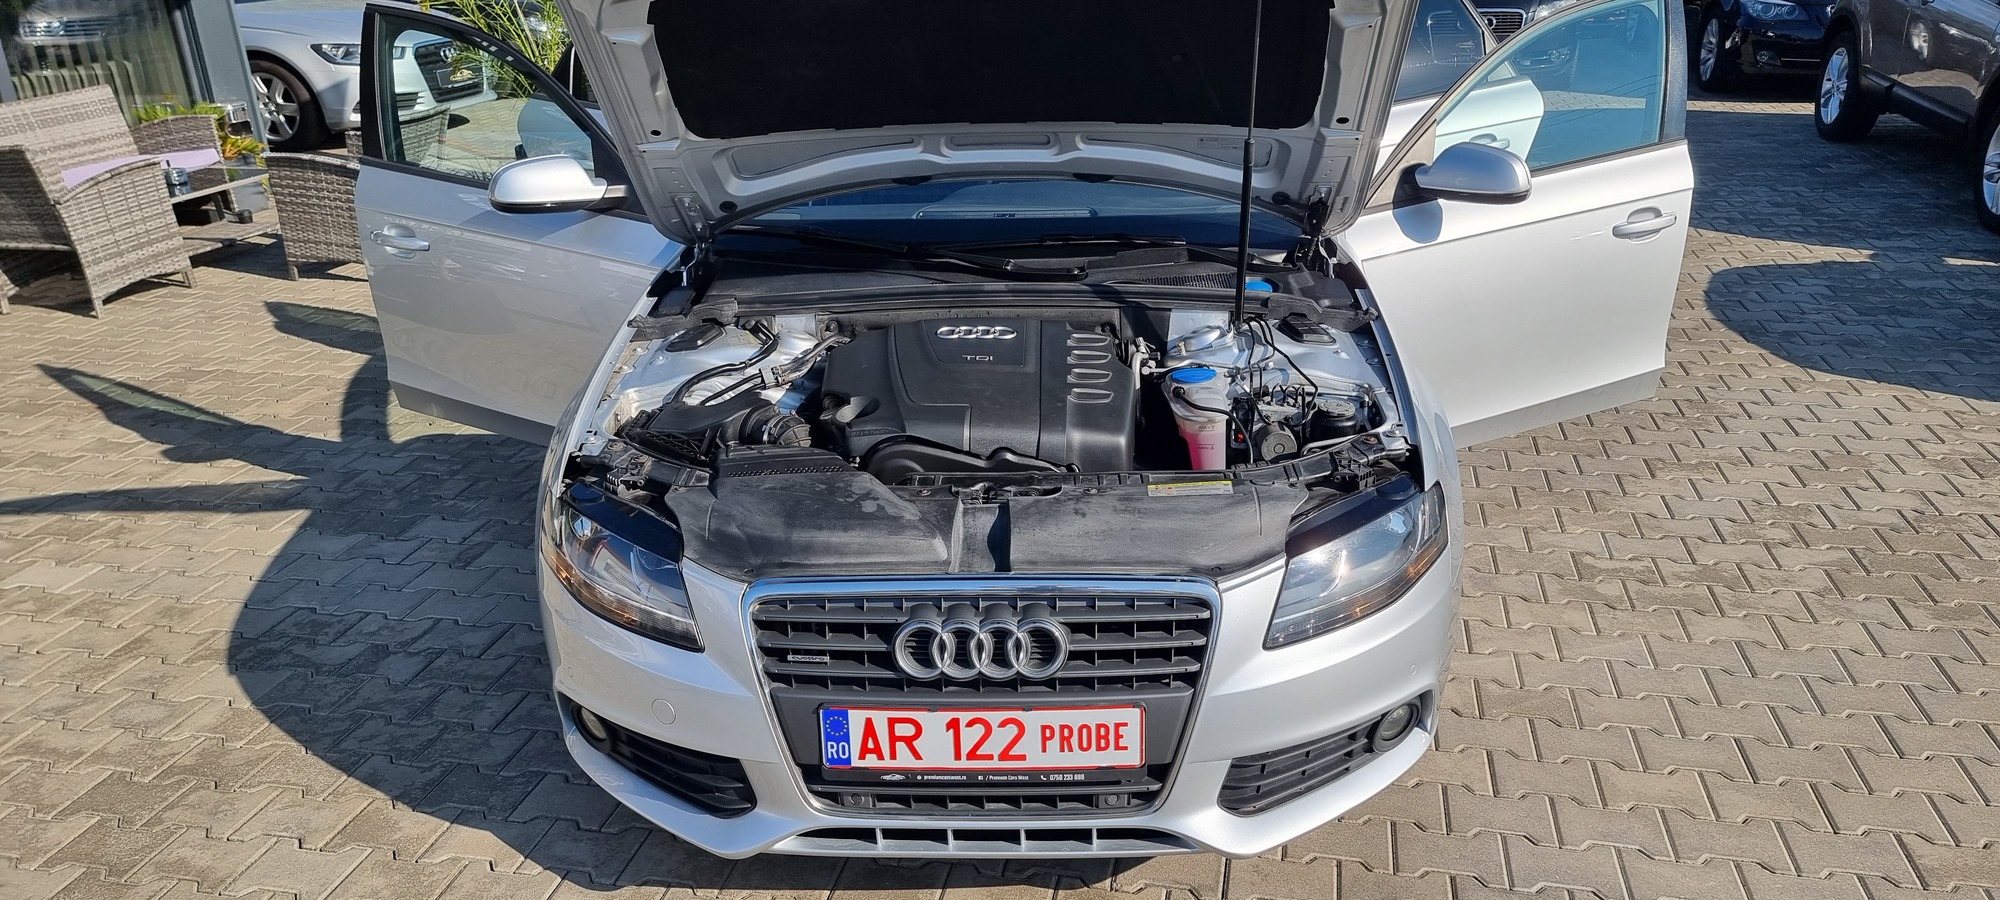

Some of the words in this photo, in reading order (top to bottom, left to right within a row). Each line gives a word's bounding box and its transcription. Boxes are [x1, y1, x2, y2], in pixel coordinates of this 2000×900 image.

[962, 354, 993, 362] TDI
[857, 716, 924, 762] AR
[945, 717, 1027, 762] 122
[1040, 721, 1129, 754] PROBE
[827, 741, 849, 759] RO
